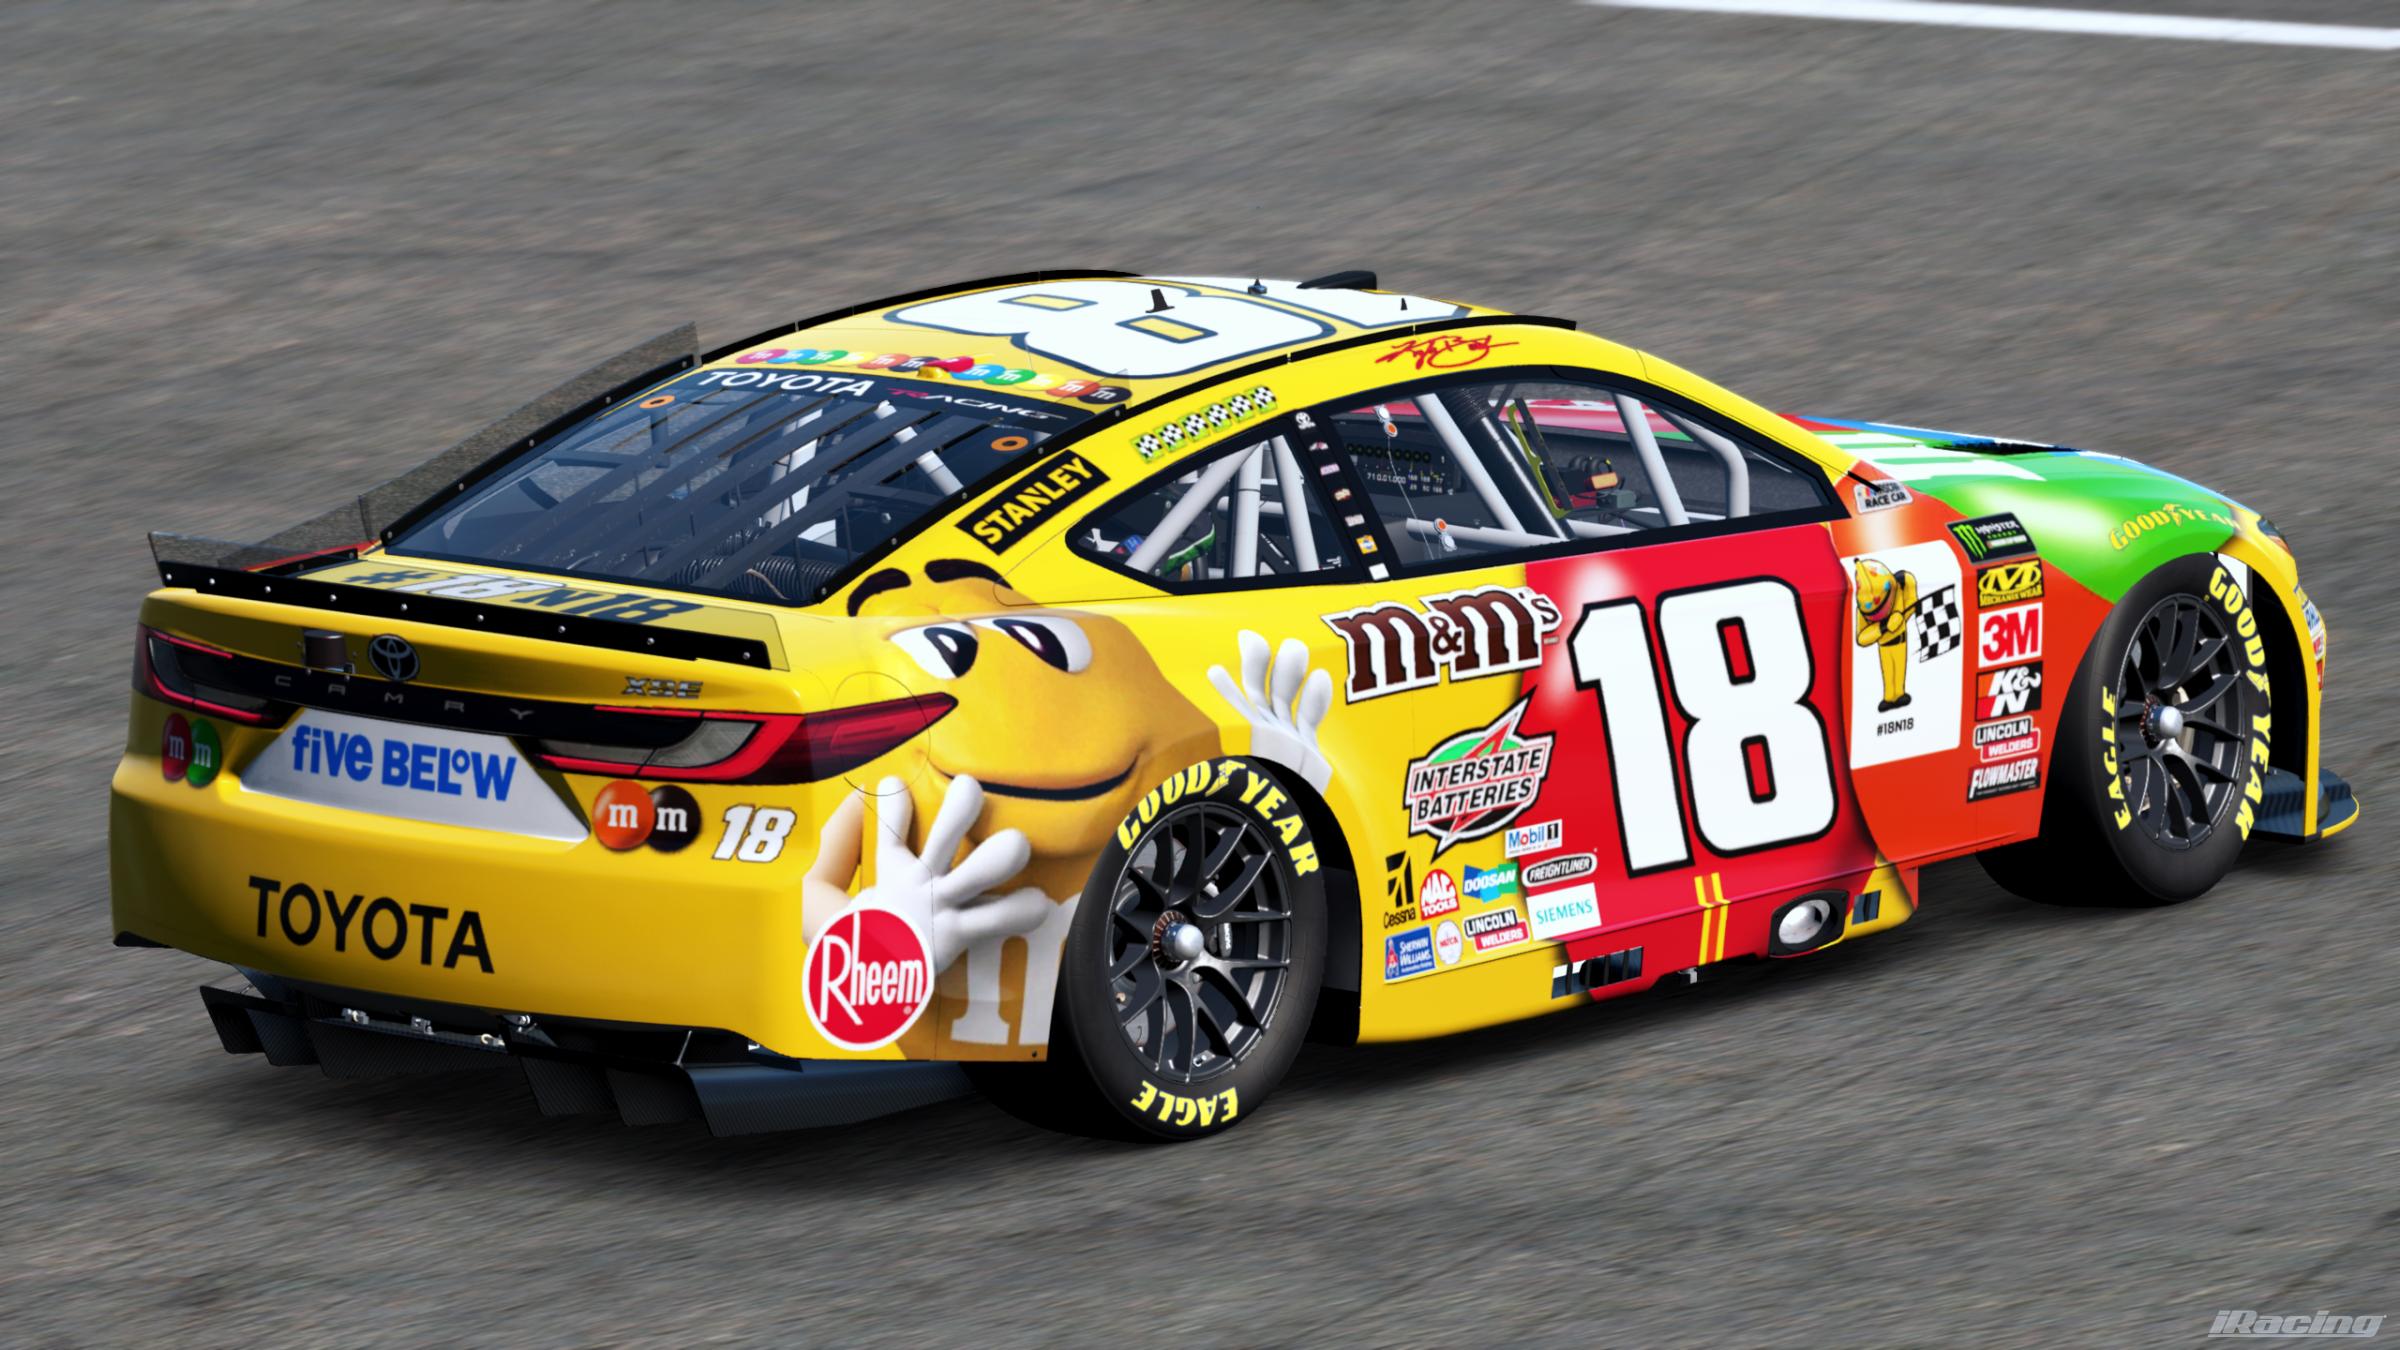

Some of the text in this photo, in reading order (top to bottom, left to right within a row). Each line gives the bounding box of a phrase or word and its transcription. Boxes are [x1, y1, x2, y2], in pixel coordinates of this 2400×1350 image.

[697, 371, 875, 397] TOYOTA
[972, 453, 1095, 546] STANLEY
[1865, 492, 1906, 508] RACE CAR
[1982, 608, 2039, 661] 3M
[274, 674, 534, 721] CAMRY
[1567, 574, 1839, 879] 18
[1876, 717, 1914, 737] #18N18
[1976, 719, 2029, 745] LINCOLN
[1987, 736, 2034, 758] WELDERS
[2101, 686, 2132, 831] EAGLE
[381, 735, 517, 802] BELOW
[1412, 747, 1543, 794] INTERSTATE
[1968, 757, 2038, 799] FLOWMASTER
[607, 790, 689, 833] m m
[1417, 777, 1532, 821] BATTERIES
[711, 803, 798, 864] 18
[1508, 825, 1545, 849] Mobil
[1549, 823, 1559, 841] 1
[1463, 869, 1517, 894] DOOSAN
[1528, 858, 1590, 882] FREIGHTLINER
[1420, 872, 1457, 907] MAC
[248, 875, 495, 974] TOYOTA
[1384, 907, 1416, 929] Cessna
[1423, 898, 1458, 917] TOOLS
[1465, 910, 1516, 936] LINCOLN
[1535, 899, 1593, 925] SIEMENS
[1400, 938, 1429, 953] SHERWIN
[1480, 928, 1524, 948] WELDERS
[820, 911, 924, 1025] Rheem
[1130, 1079, 1239, 1127] EAGLE
